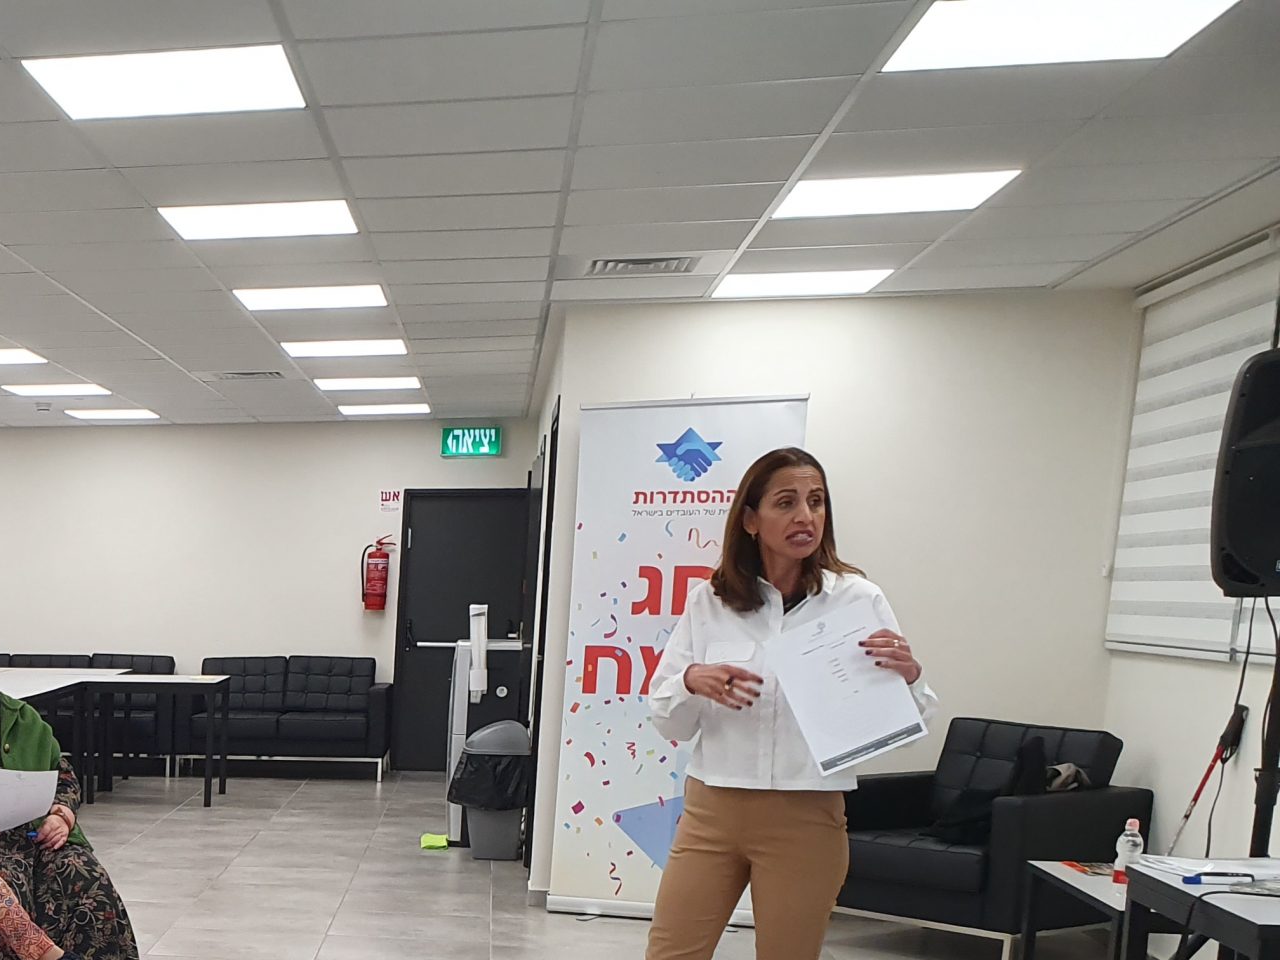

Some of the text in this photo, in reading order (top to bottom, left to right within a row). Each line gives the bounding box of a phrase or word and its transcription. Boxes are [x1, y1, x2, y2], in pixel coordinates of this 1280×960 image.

[452, 429, 496, 454] יציאה
[381, 490, 400, 502] אש
[632, 509, 664, 517] בישראל
[666, 508, 701, 517] העובדים
[704, 508, 716, 516] של
